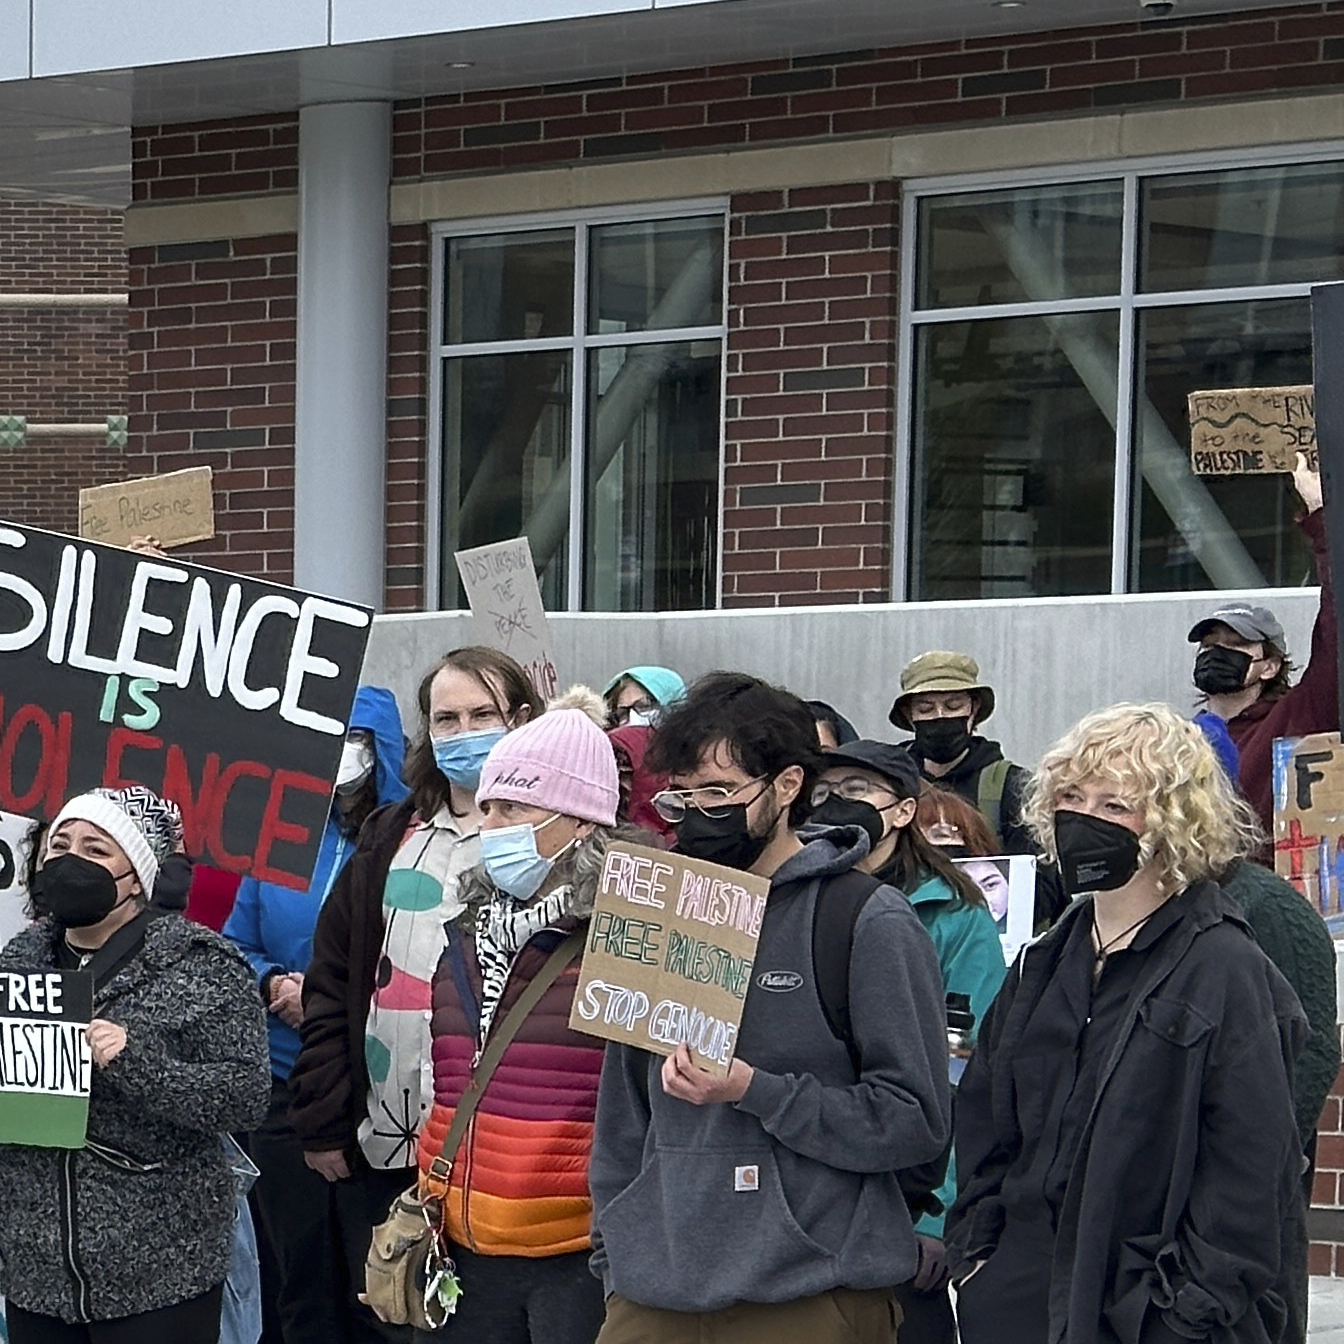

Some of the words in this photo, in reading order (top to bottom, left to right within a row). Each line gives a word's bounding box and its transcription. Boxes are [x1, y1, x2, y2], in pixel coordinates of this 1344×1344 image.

[1194, 394, 1240, 416] FROM
[1283, 394, 1315, 423] RIV
[81, 504, 111, 537] Free
[117, 495, 195, 529] Palestine
[492, 577, 516, 602] THE
[98, 675, 162, 731] IS
[487, 766, 542, 795] phat
[601, 850, 675, 910] FREE
[675, 868, 767, 939] PALESTINE
[590, 911, 663, 966] FREE
[664, 928, 753, 1000] PALESTINE
[577, 978, 650, 1033] STOP
[648, 998, 738, 1066] GENOCIDE
